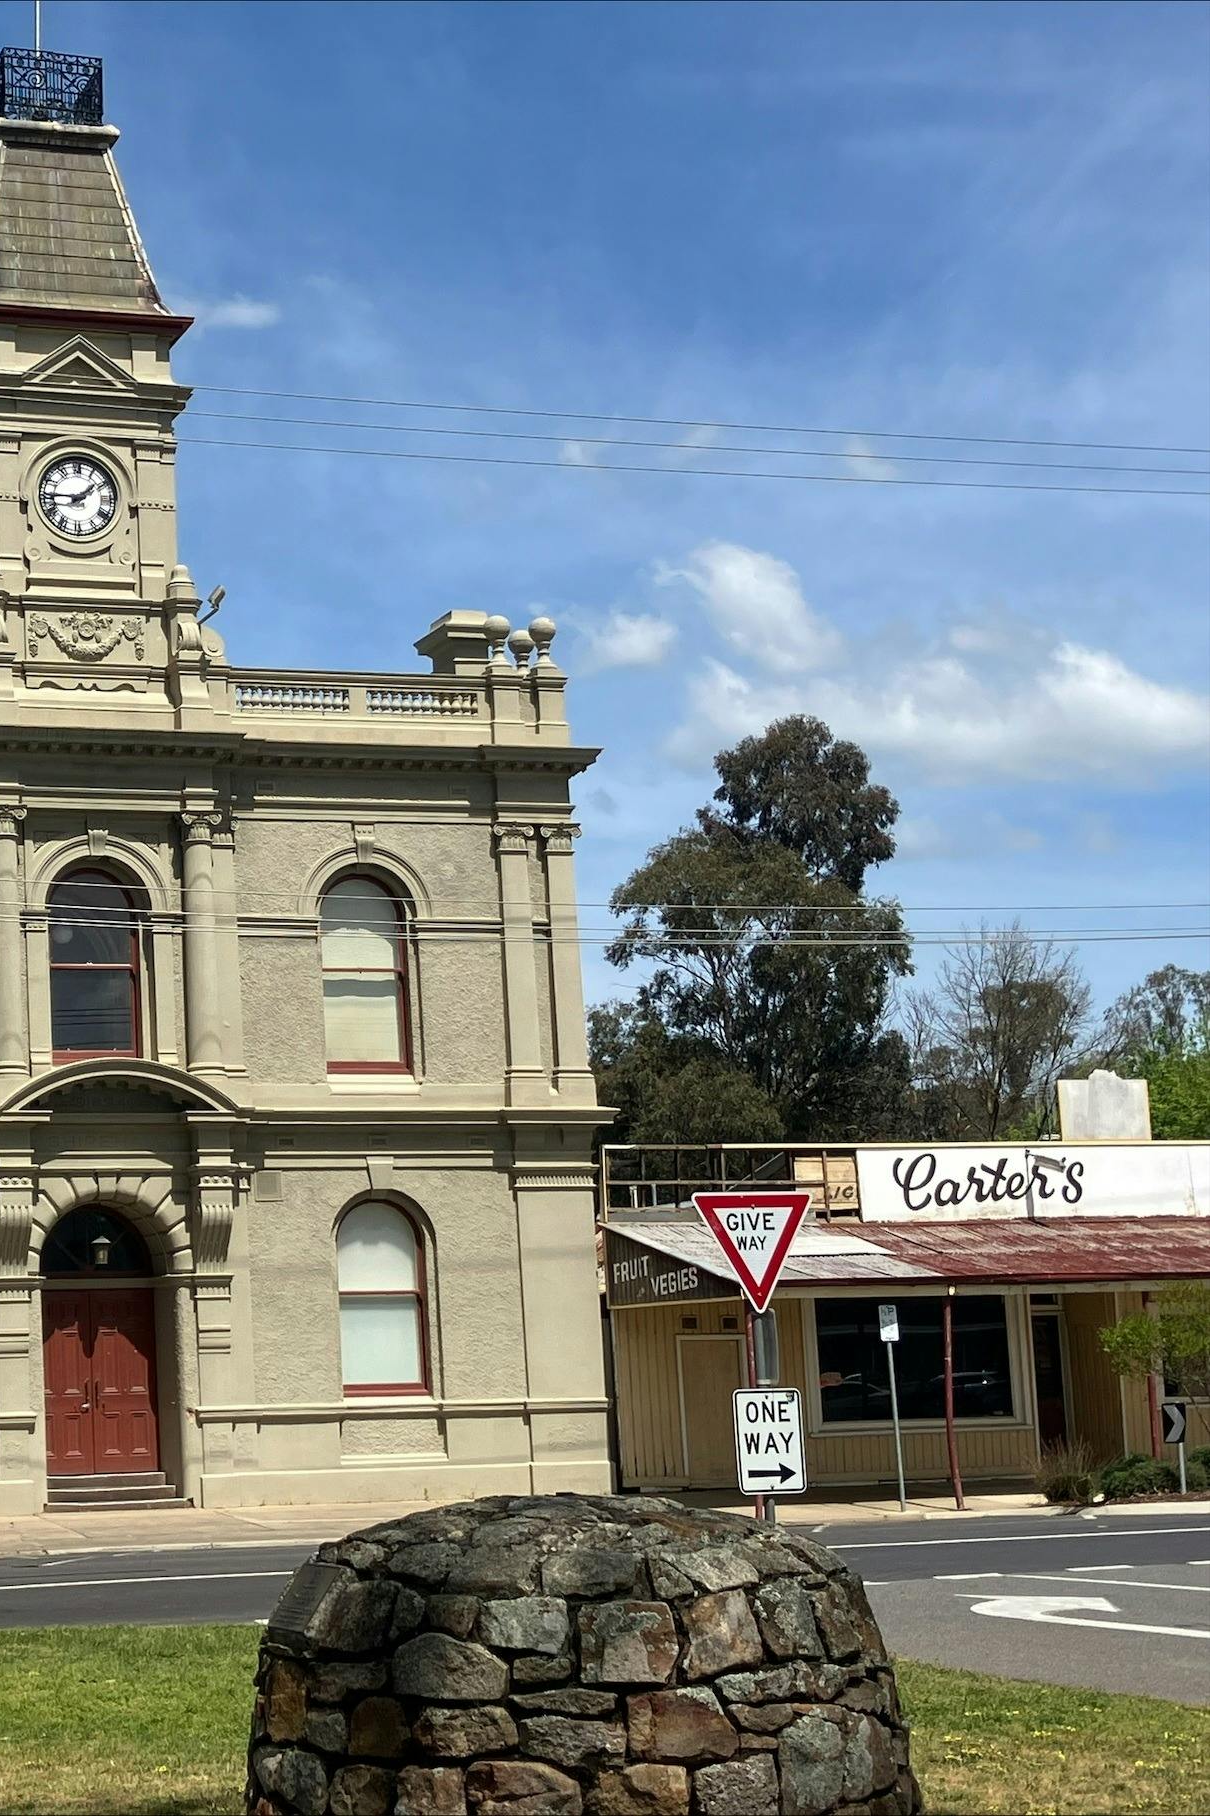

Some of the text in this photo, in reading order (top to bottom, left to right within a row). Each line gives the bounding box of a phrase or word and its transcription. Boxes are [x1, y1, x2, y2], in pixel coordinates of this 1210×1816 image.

[726, 1212, 775, 1231] GIVE
[736, 1236, 767, 1250] WAY
[613, 1255, 649, 1284] FRUIT
[650, 1266, 699, 1296] VEGIES
[746, 1401, 791, 1423] ONE
[744, 1432, 794, 1455] WAY
